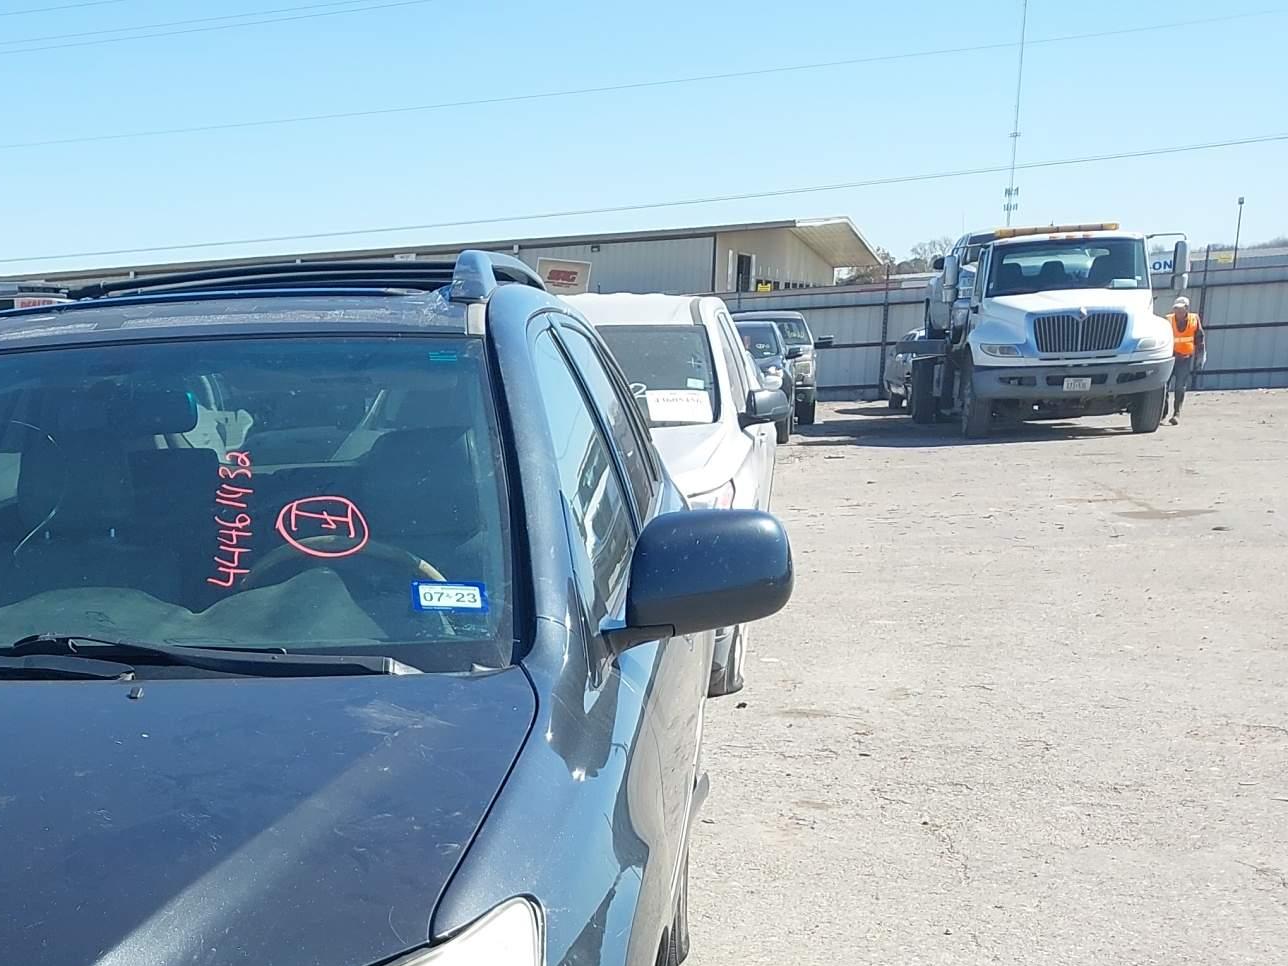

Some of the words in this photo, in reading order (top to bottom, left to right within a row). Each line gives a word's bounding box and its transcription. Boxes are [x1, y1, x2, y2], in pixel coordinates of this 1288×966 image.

[207, 451, 253, 588] 44461432
[423, 591, 444, 602] 07
[455, 592, 477, 603] 23
